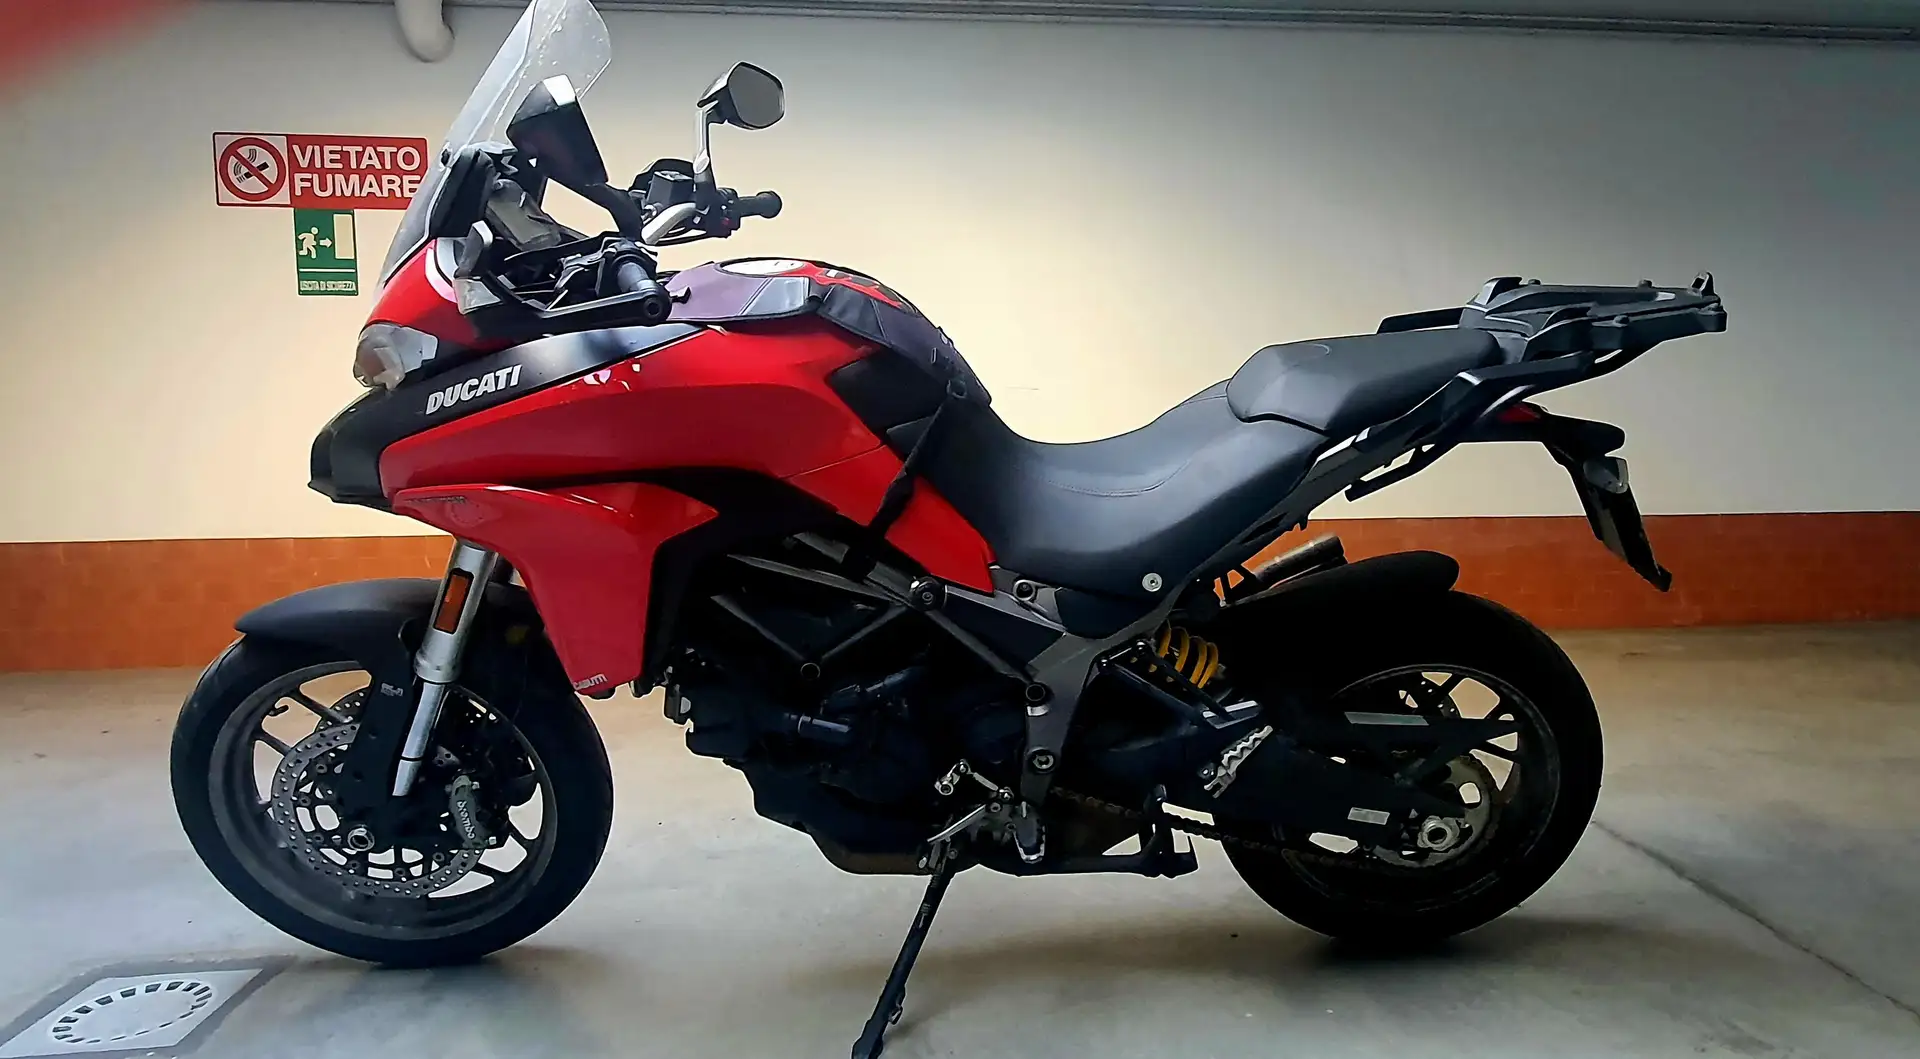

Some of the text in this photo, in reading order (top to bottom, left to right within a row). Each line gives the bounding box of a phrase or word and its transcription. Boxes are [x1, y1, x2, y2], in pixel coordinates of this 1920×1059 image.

[292, 145, 421, 171] VIETATO
[294, 173, 421, 198] FUMARE
[425, 364, 523, 415] DUCATI
